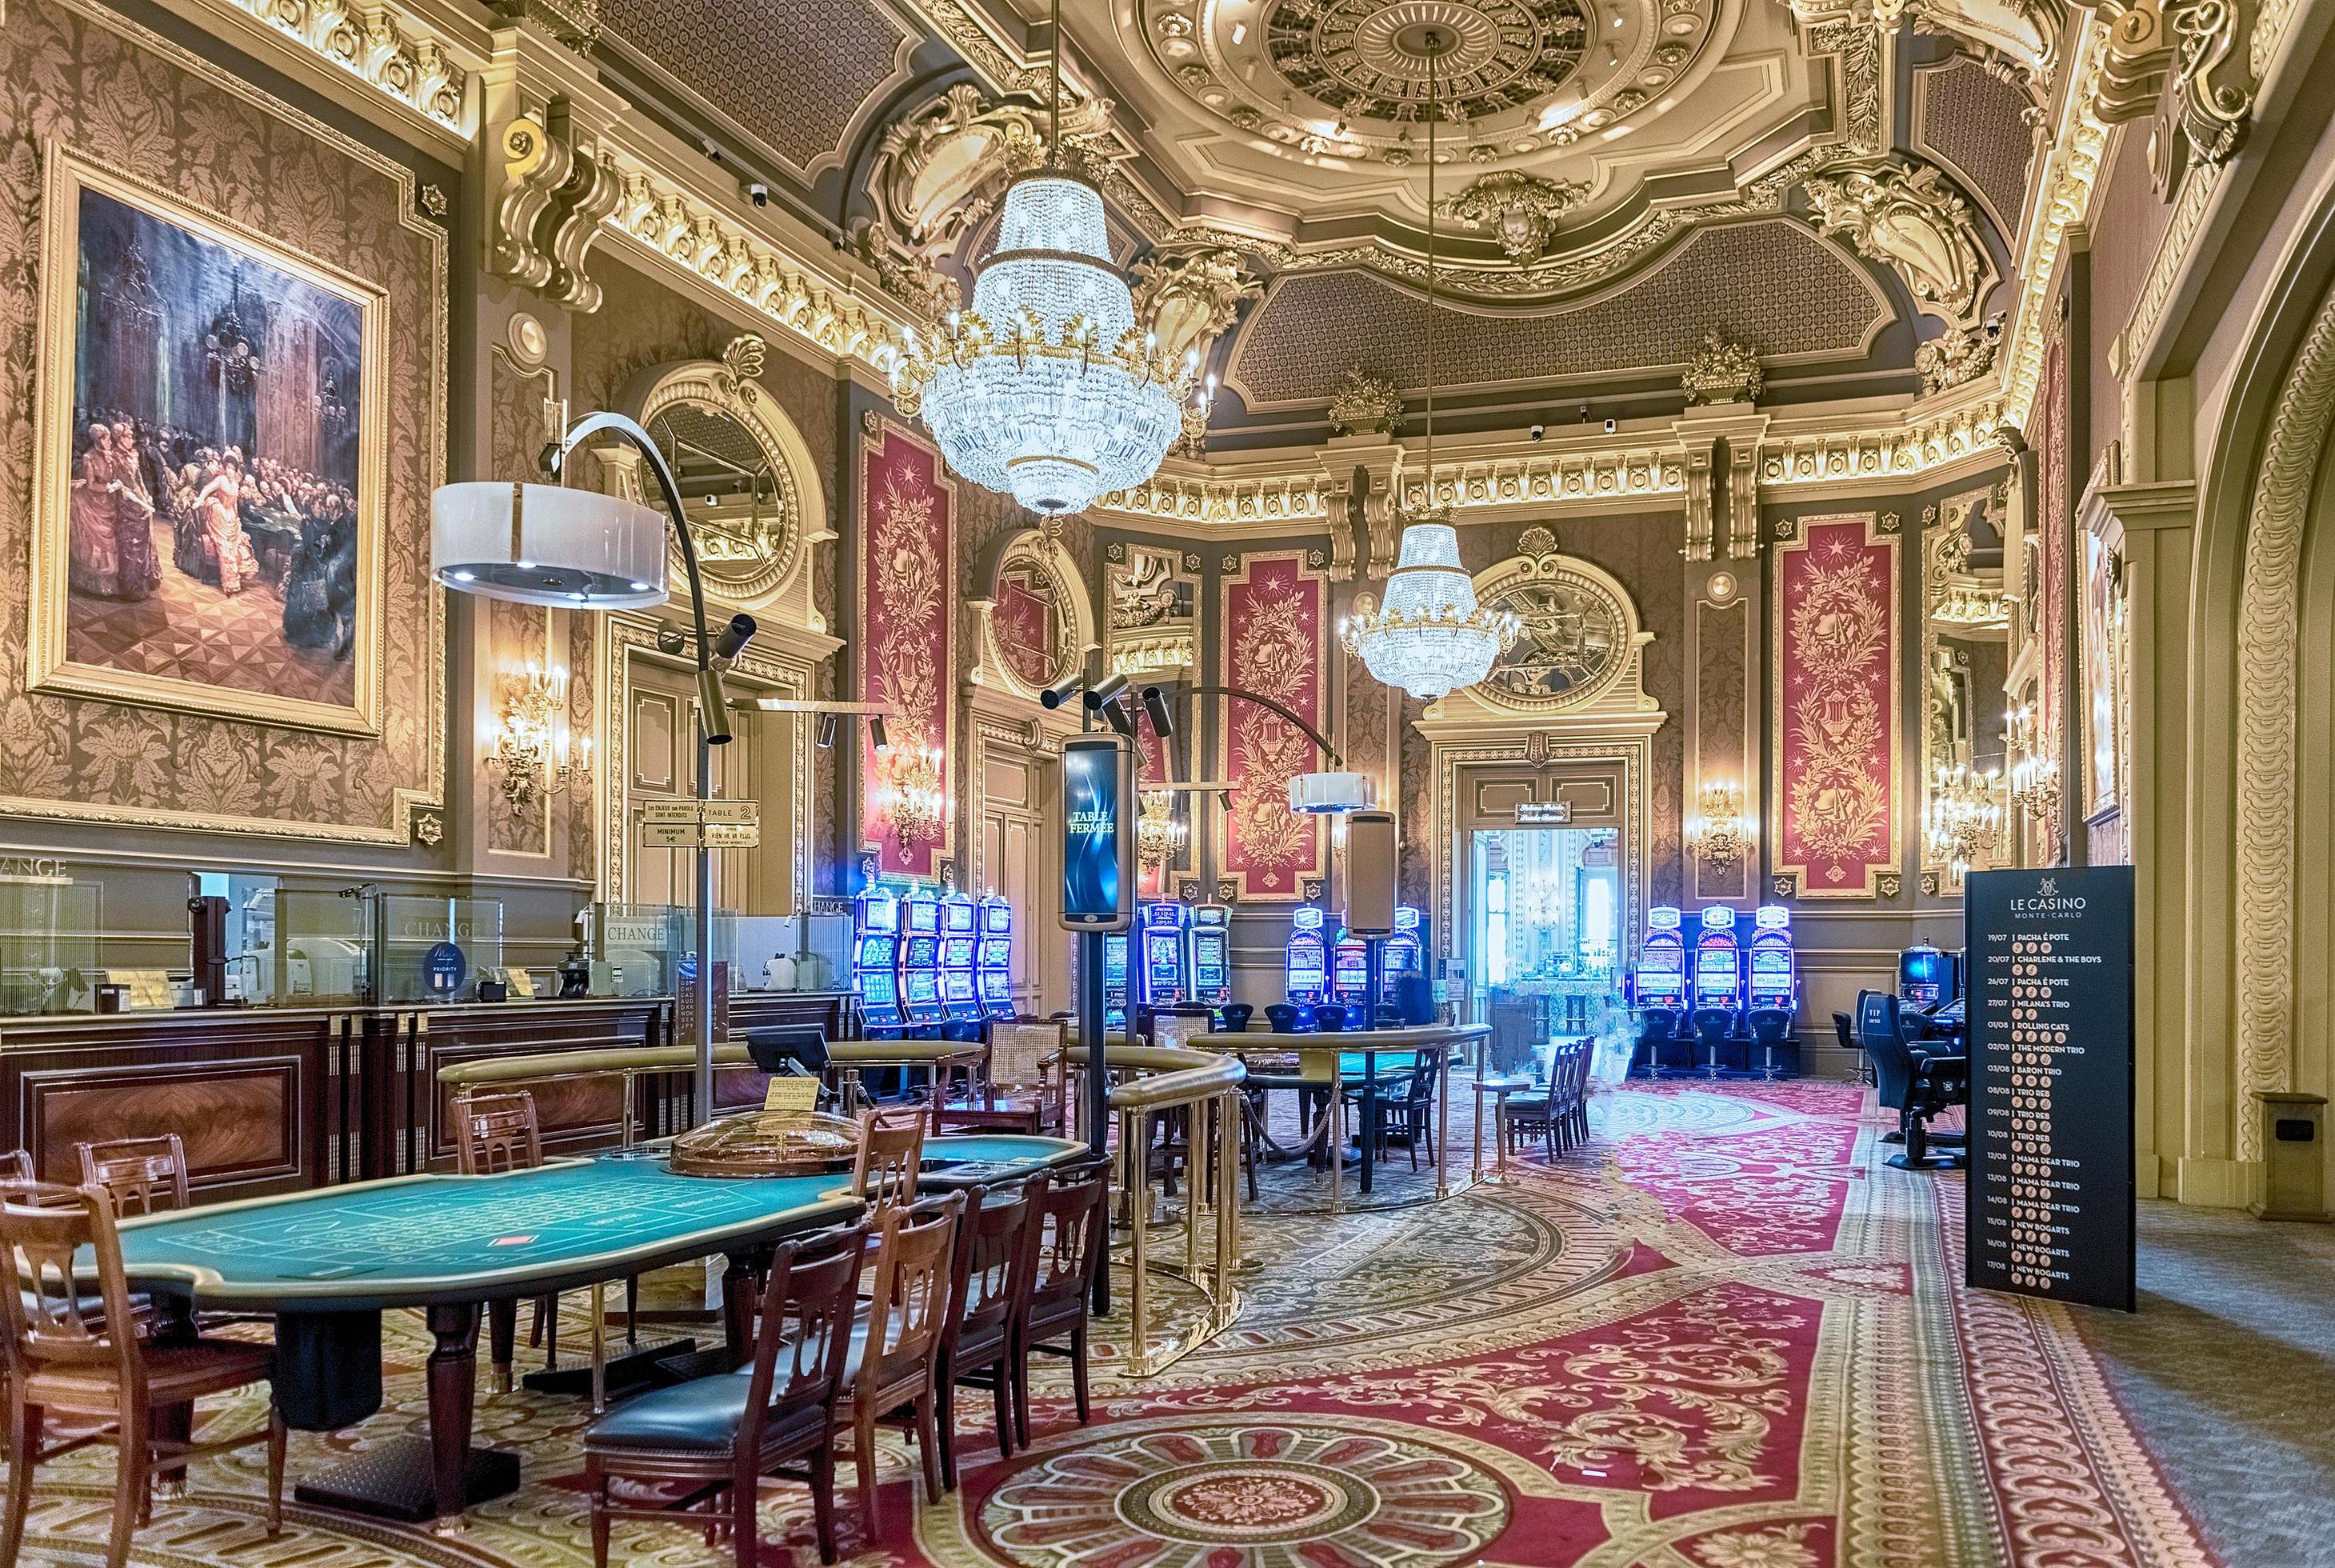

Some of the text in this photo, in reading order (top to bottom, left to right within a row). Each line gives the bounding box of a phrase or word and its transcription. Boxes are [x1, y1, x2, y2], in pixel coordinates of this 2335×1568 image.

[740, 806, 751, 819] 2
[1073, 811, 1108, 822] TABLE
[1070, 822, 1114, 833] FERMÉE
[2011, 897, 2086, 910] LE CASINO
[607, 926, 665, 941] CHANGE
[1869, 1009, 1881, 1017] VIP
[2033, 1045, 2065, 1053] MODERN
[2067, 1046, 2085, 1054] TRIO
[2017, 1066, 2042, 1074] BARON
[2044, 1068, 2061, 1076] TRIO
[2017, 1155, 2040, 1164] MAMA
[2041, 1158, 2061, 1166] DEAR
[2061, 1159, 2080, 1168] TRIO
[2017, 1177, 2040, 1186] MAMA
[2041, 1180, 2061, 1189] DEAR
[2061, 1182, 2080, 1190] TRIO
[2017, 1199, 2040, 1209] MAMA
[2041, 1202, 2061, 1211] DEAR
[2061, 1205, 2080, 1214] TRIO
[2017, 1222, 2033, 1230] NEW
[2035, 1223, 2069, 1234] BOGARTS
[2017, 1243, 2033, 1252] NEW
[2035, 1246, 2069, 1258] BOGARTS
[2017, 1266, 2033, 1274] NEW
[2035, 1268, 2069, 1280] BOGARTS
